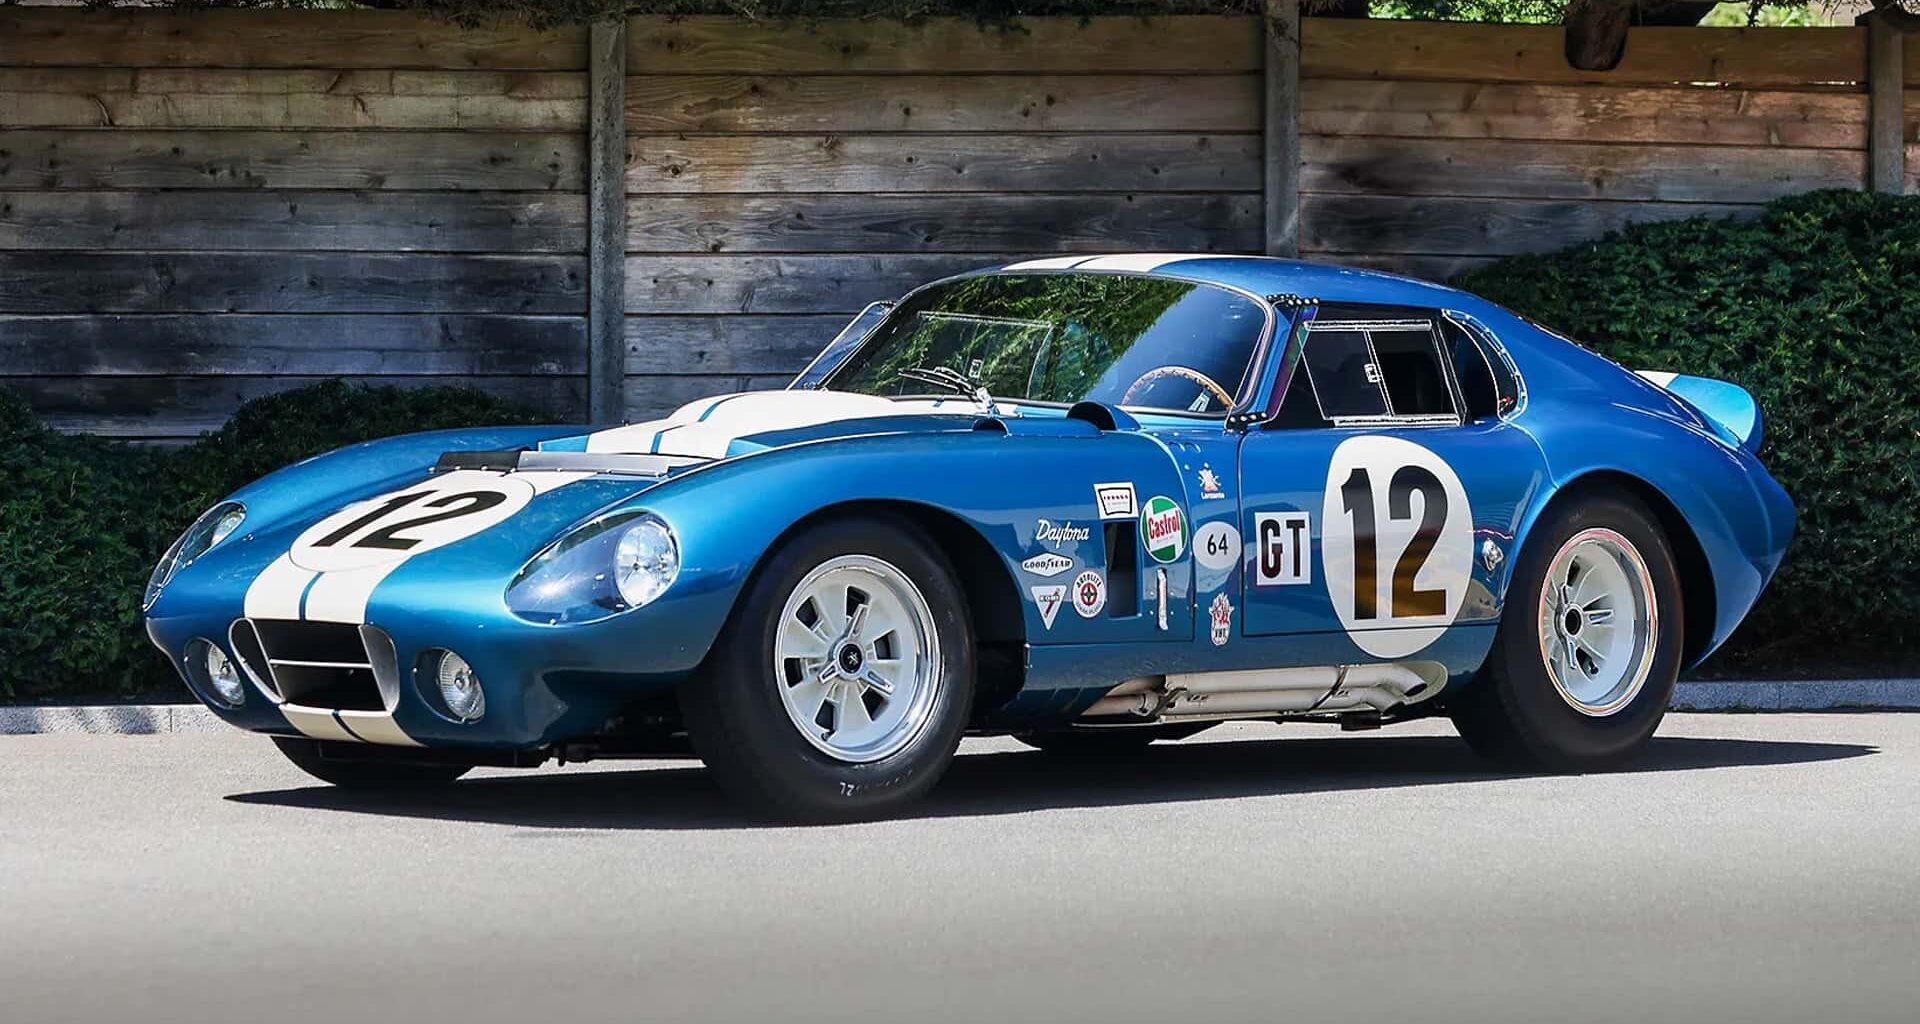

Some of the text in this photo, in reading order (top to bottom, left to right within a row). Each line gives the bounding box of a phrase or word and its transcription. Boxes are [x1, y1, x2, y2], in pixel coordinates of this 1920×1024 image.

[309, 489, 507, 551] 12
[1036, 519, 1090, 549] Daytona
[1148, 510, 1181, 540] Castrol
[1340, 464, 1448, 620] 12
[1207, 533, 1228, 556] 64
[1260, 519, 1305, 579] GT
